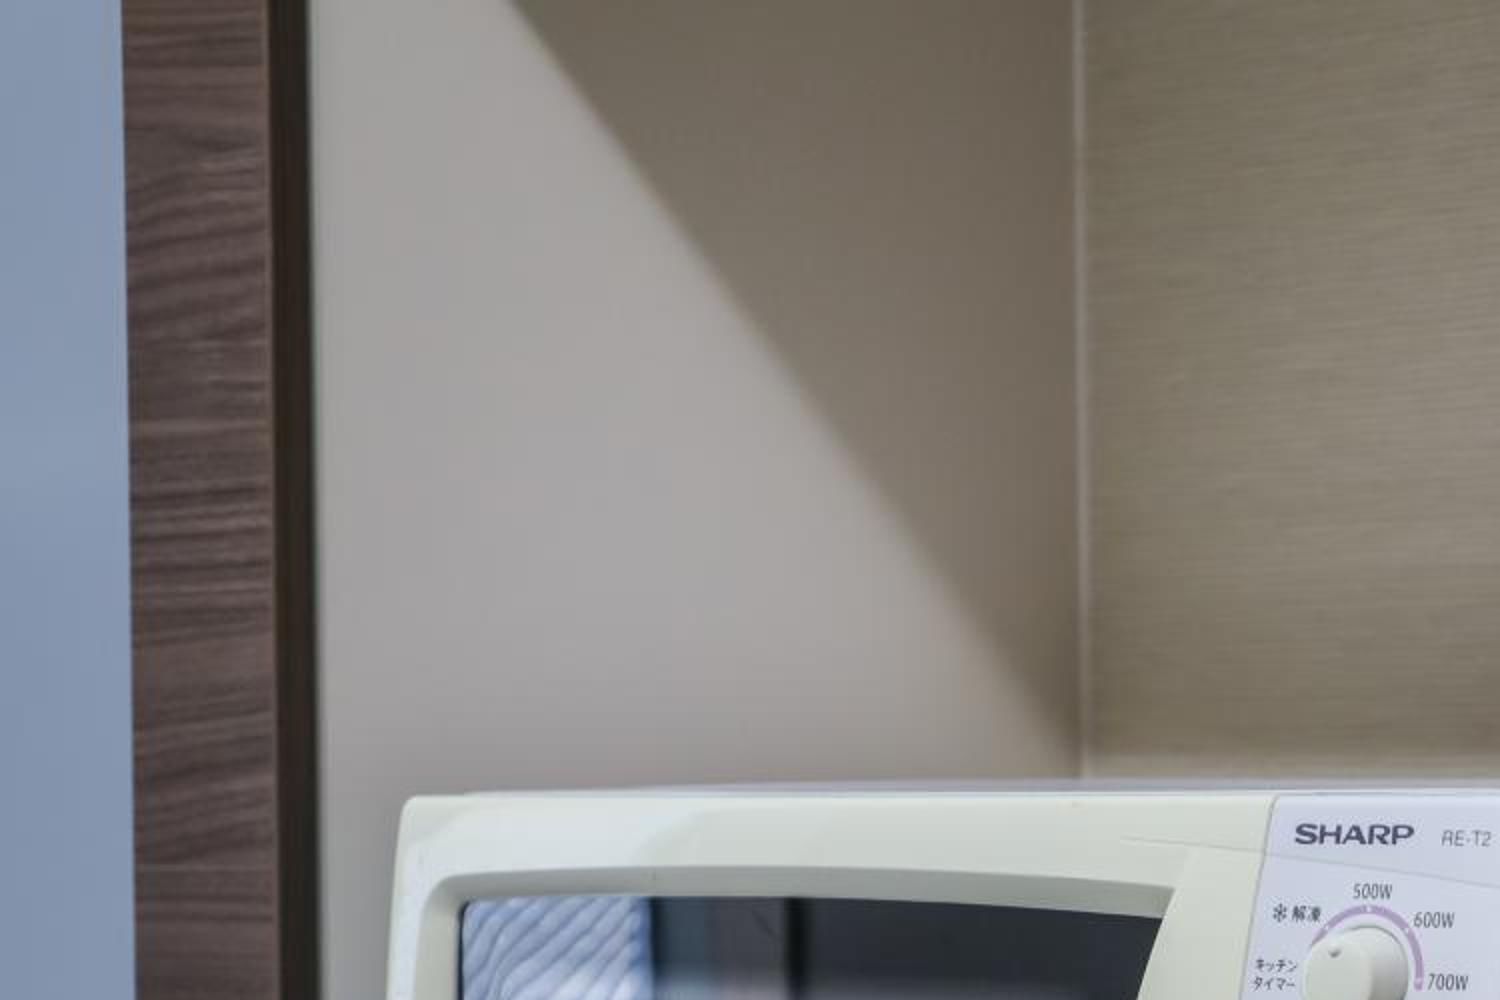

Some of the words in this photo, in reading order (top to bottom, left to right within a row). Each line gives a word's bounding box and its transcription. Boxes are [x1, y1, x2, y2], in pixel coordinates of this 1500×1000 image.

[1295, 823, 1415, 845] SHARP
[1442, 830, 1492, 846] RE-T2
[1353, 883, 1393, 900] 500W
[1291, 905, 1321, 922] 解凍
[1413, 911, 1455, 928] 600W
[1255, 959, 1298, 972] キッチン
[1253, 977, 1296, 991] タイマー
[1428, 974, 1468, 991] 700W
